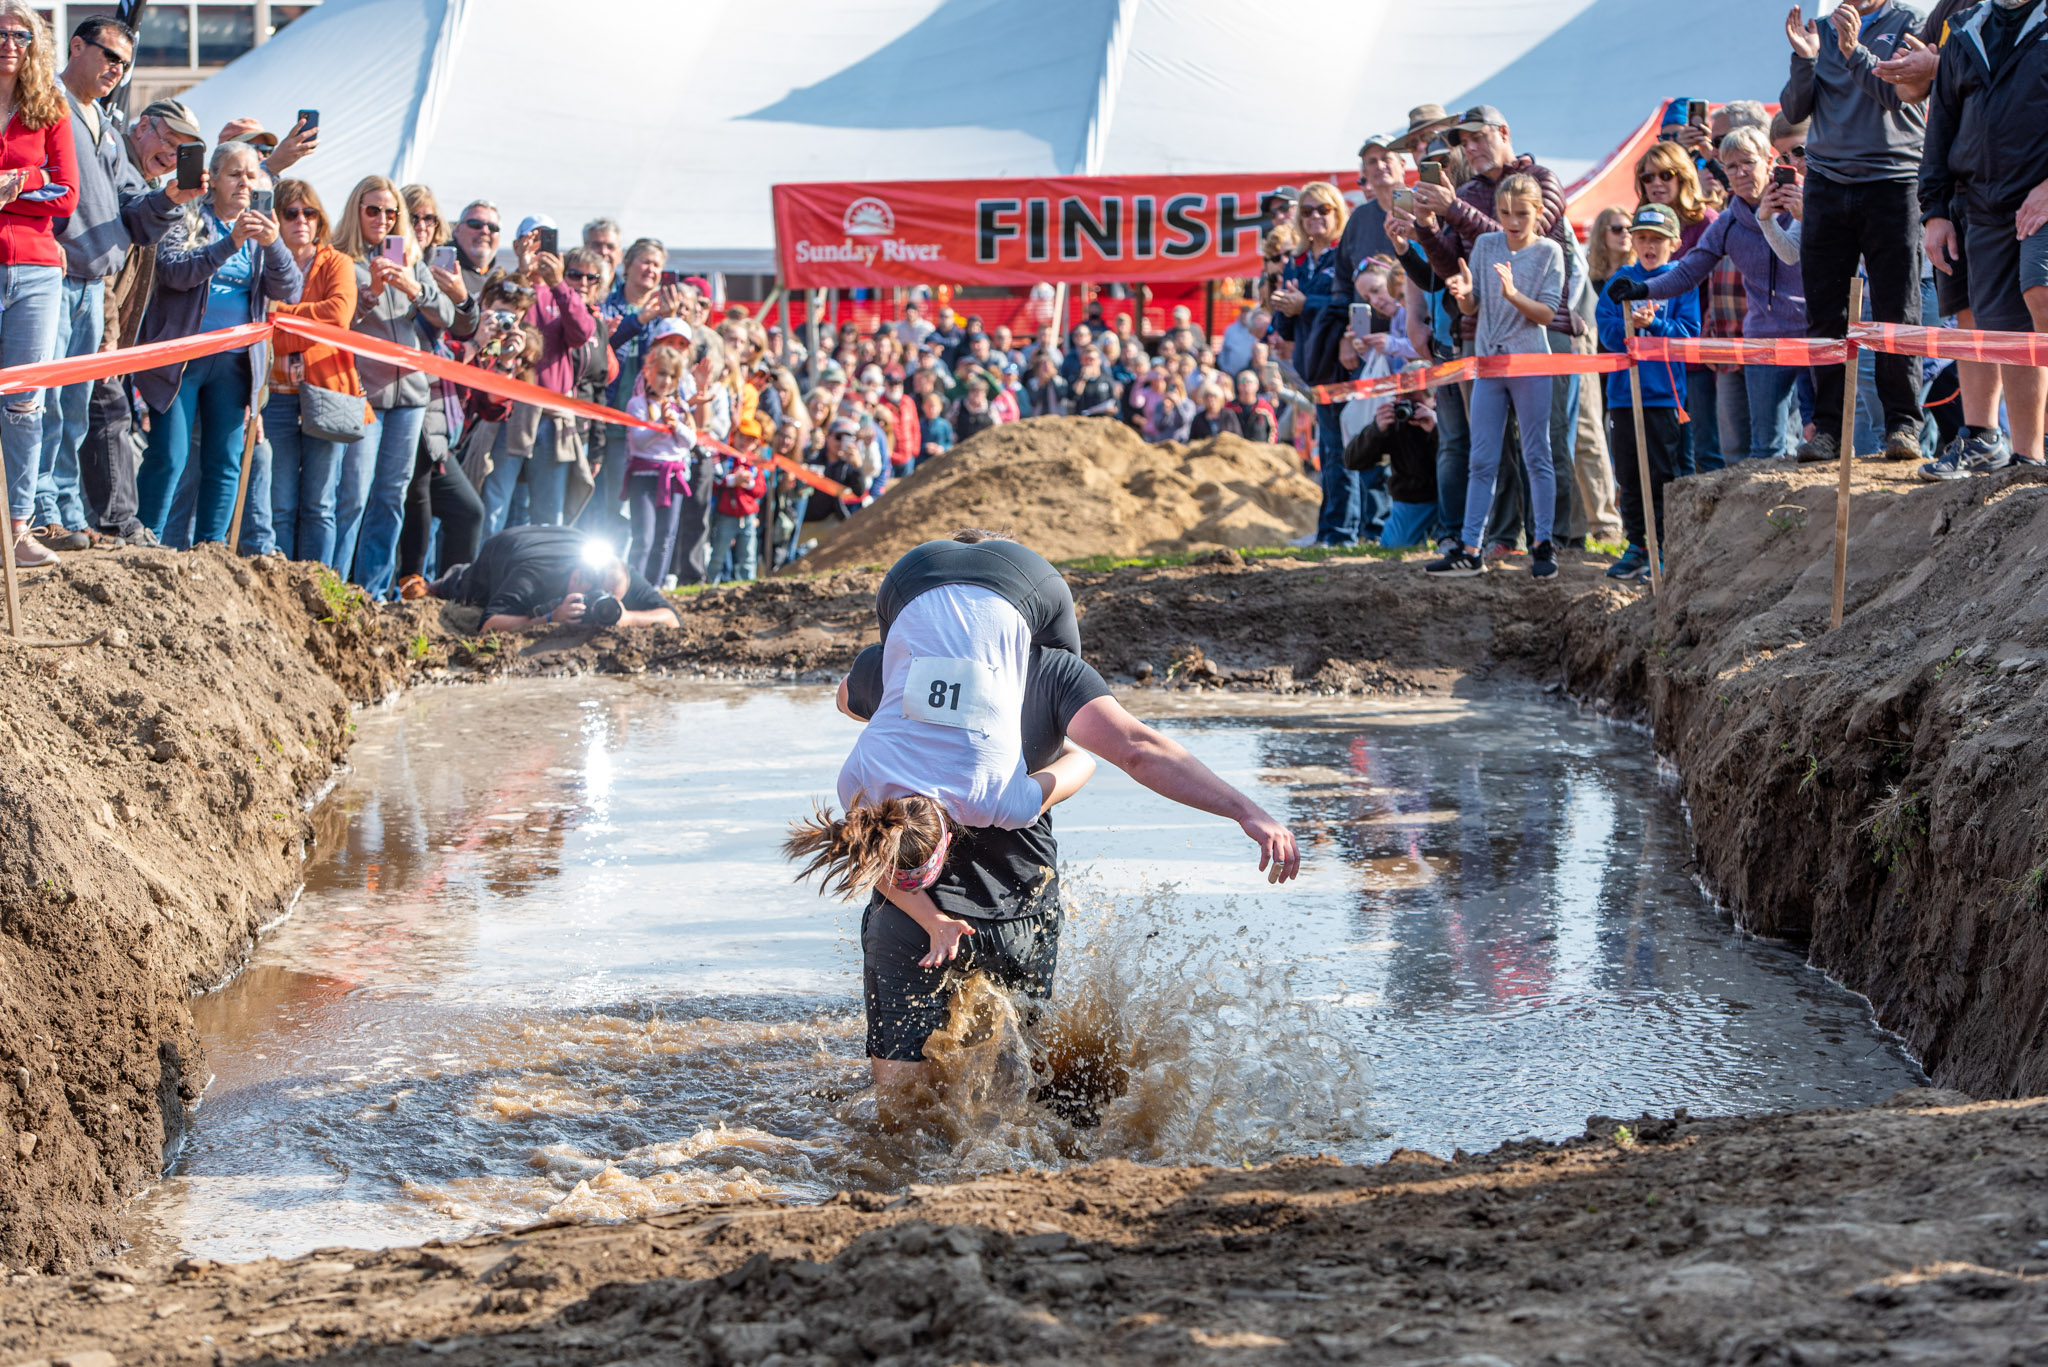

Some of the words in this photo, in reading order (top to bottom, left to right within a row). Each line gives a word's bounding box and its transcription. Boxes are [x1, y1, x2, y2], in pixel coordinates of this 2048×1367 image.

[976, 193, 1273, 264] FINISH
[796, 237, 878, 267] Sunday
[882, 238, 942, 261] River
[928, 680, 961, 710] 81
